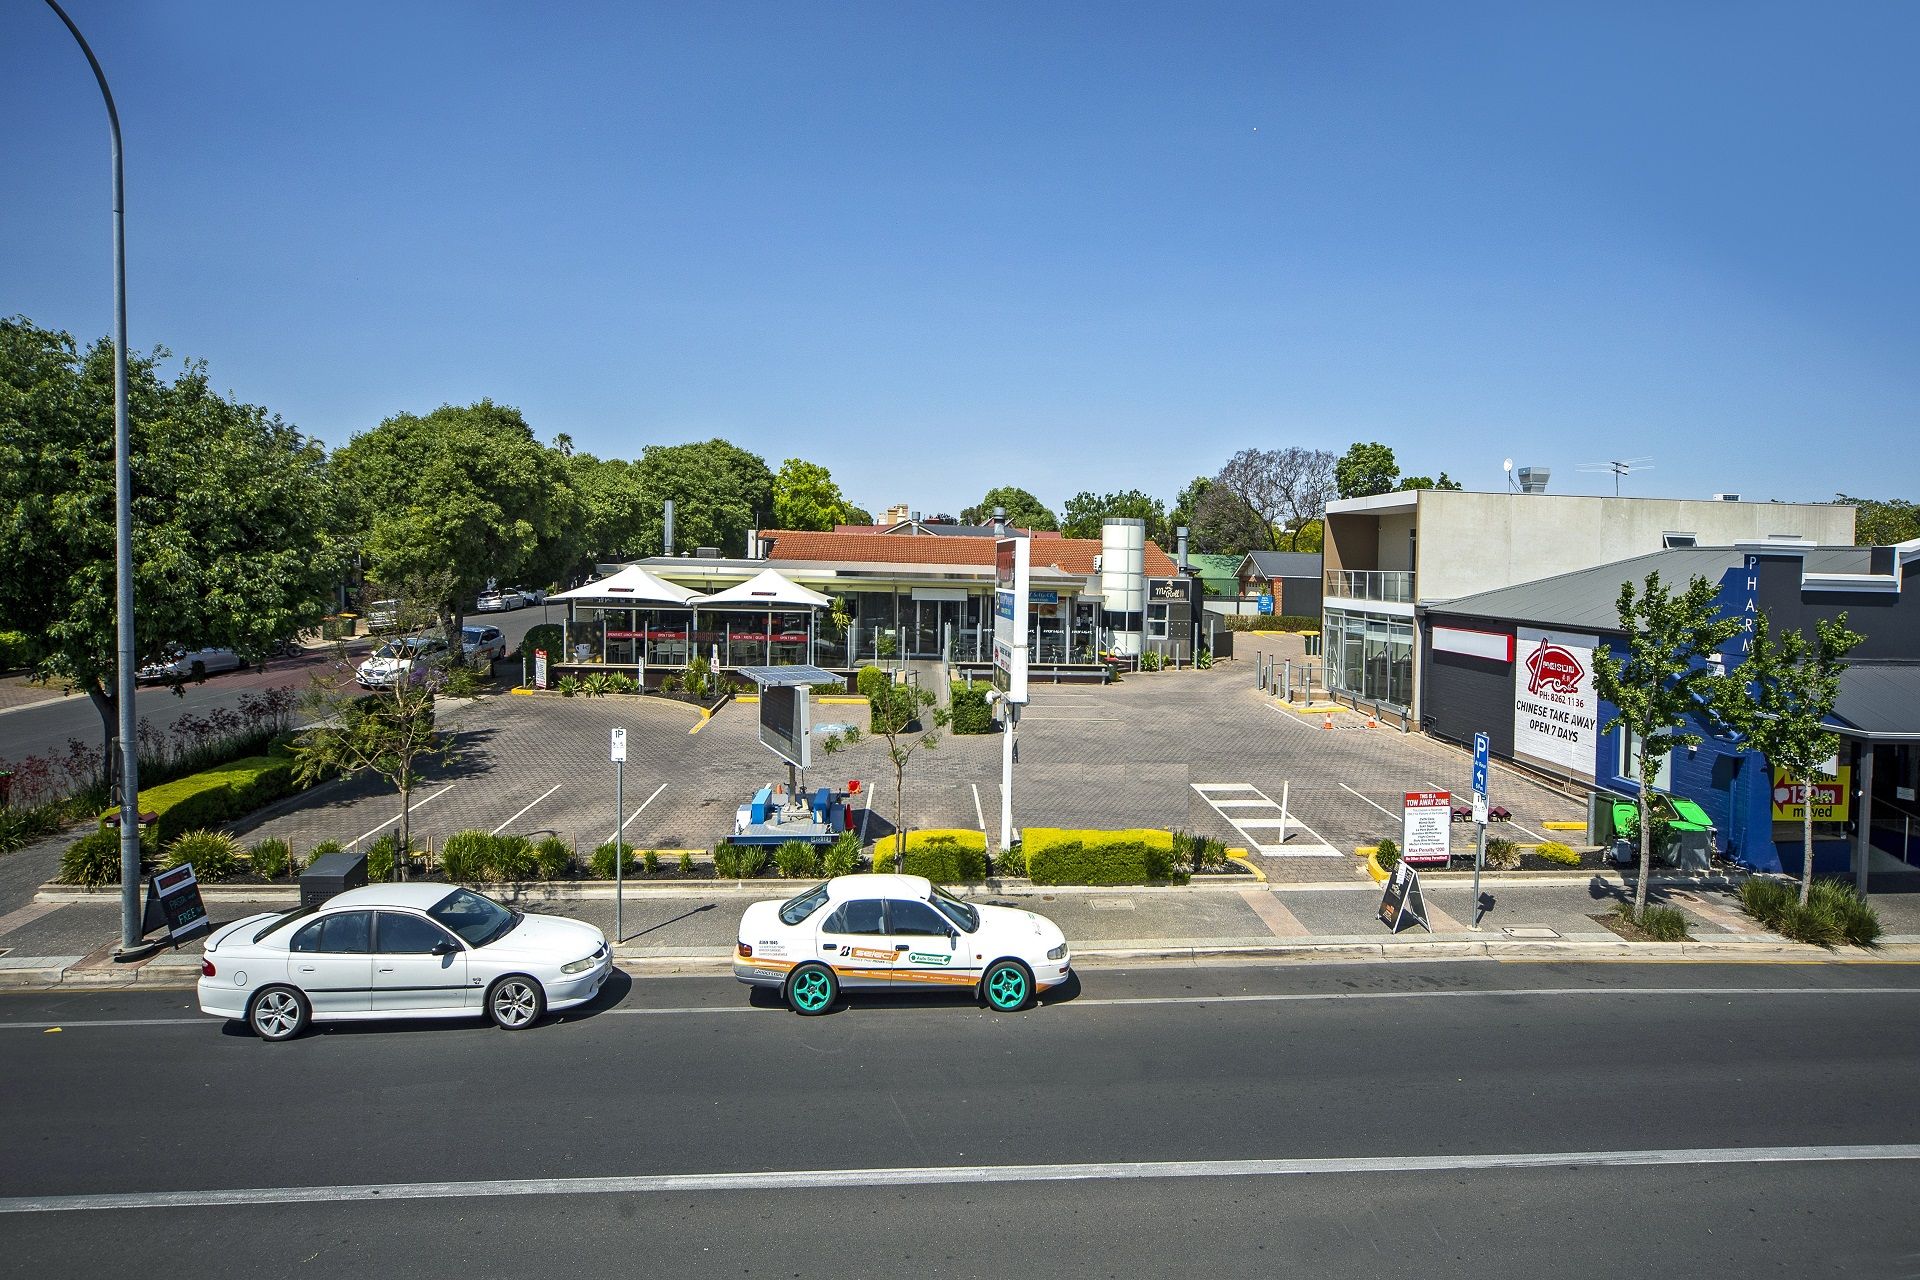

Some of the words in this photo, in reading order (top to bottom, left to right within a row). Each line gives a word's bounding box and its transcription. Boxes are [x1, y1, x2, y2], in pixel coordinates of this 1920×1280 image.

[1540, 691, 1550, 701] PH:
[1551, 693, 1566, 704] 8262
[1568, 697, 1584, 708] 1136
[1516, 700, 1547, 718] CHINESE
[1549, 708, 1569, 724] TAKE
[1570, 714, 1596, 731] AWAY
[1529, 719, 1550, 735] OPEN
[1551, 725, 1556, 736] 7
[1557, 726, 1579, 743] DAYS
[1477, 738, 1486, 758] P
[1435, 798, 1449, 806] ZONE
[1793, 805, 1833, 818] mved
[178, 907, 197, 925] FREE
